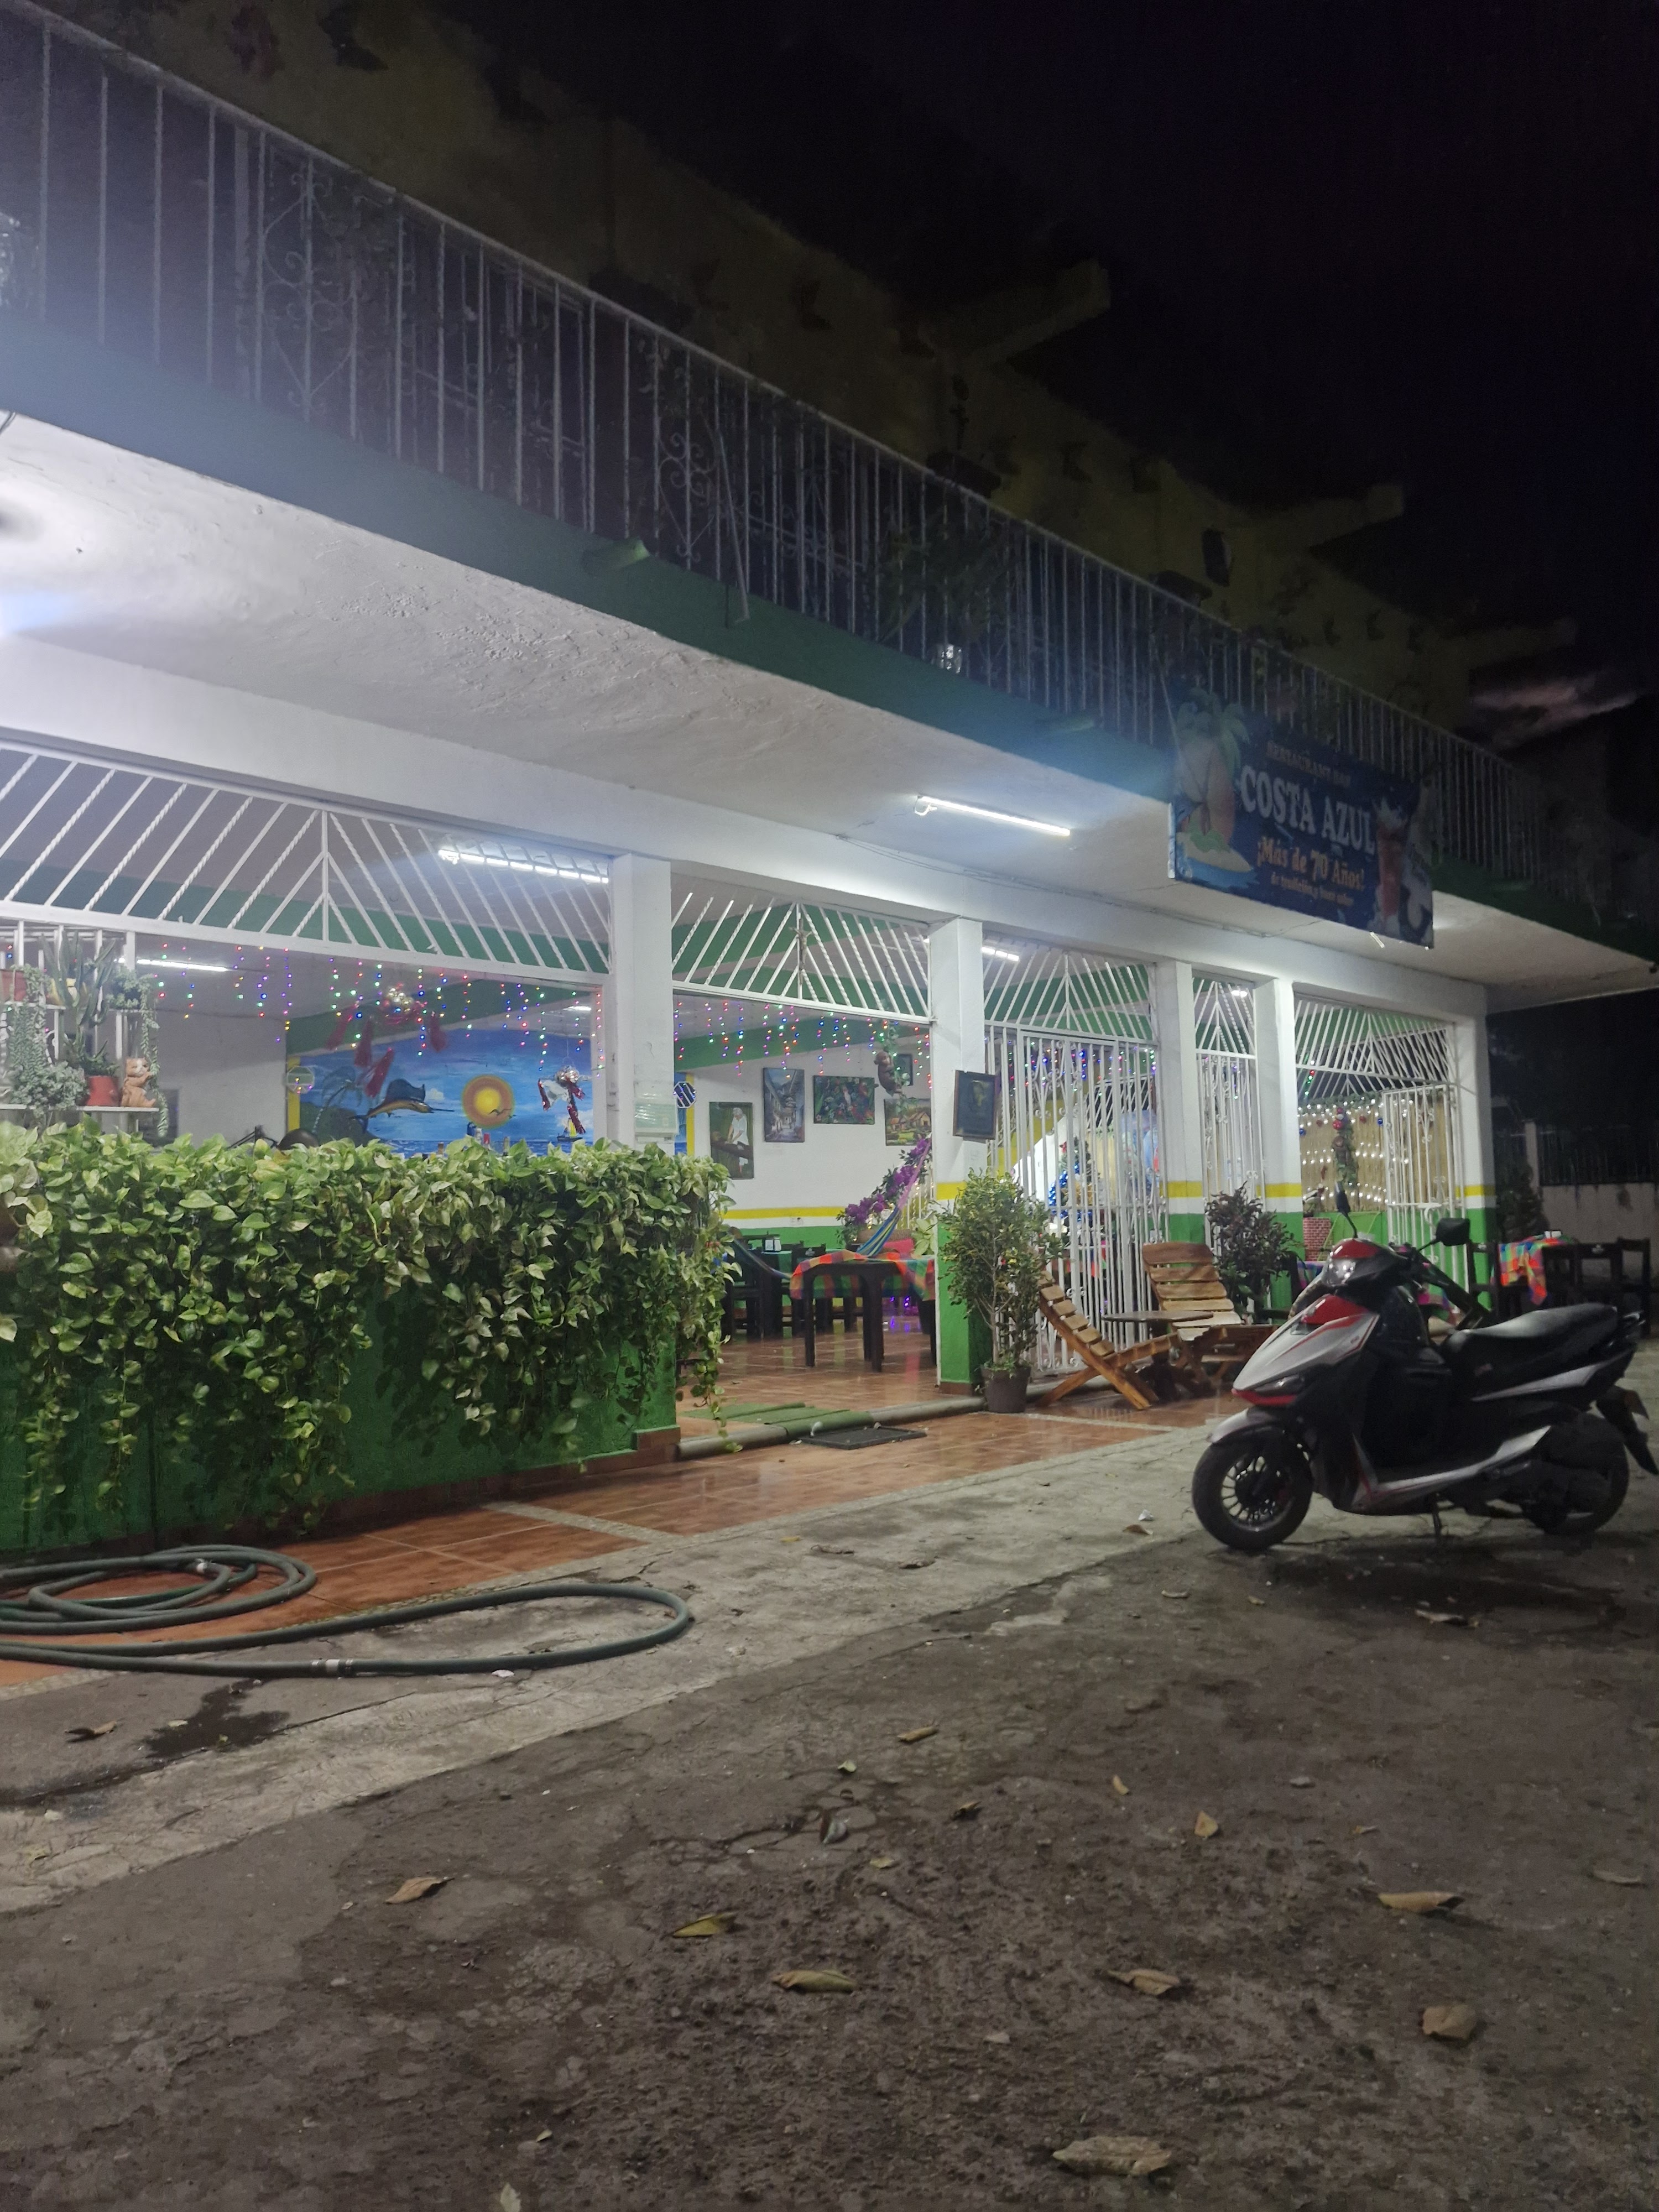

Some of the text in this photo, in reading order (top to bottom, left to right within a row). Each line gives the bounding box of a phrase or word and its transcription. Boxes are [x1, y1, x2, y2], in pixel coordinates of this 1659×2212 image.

[1240, 765, 1375, 855] COSTA AZUL
[1291, 847, 1307, 873] de
[1310, 849, 1329, 882] 70
